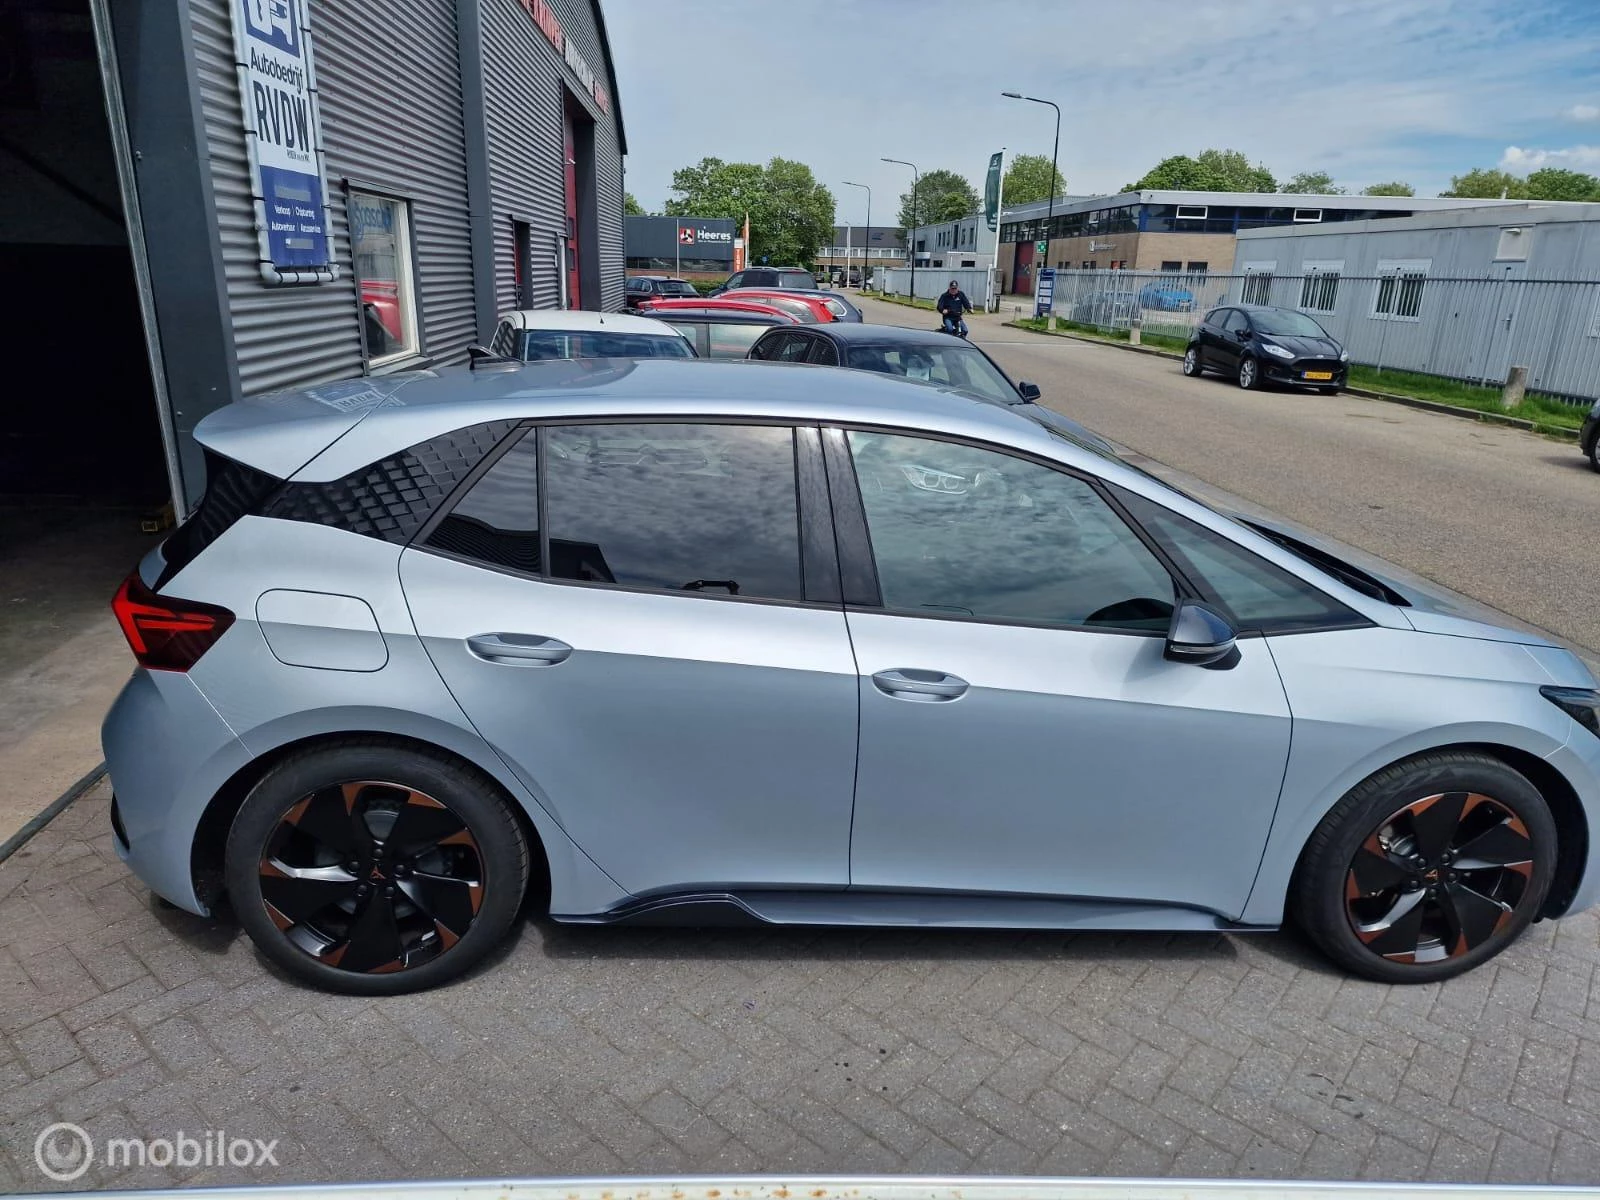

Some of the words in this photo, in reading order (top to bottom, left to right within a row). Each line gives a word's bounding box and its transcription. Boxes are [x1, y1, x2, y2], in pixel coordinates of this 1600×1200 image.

[251, 47, 304, 95] Autobedrijf
[253, 80, 310, 153] RVDW
[697, 229, 731, 240] Heeres
